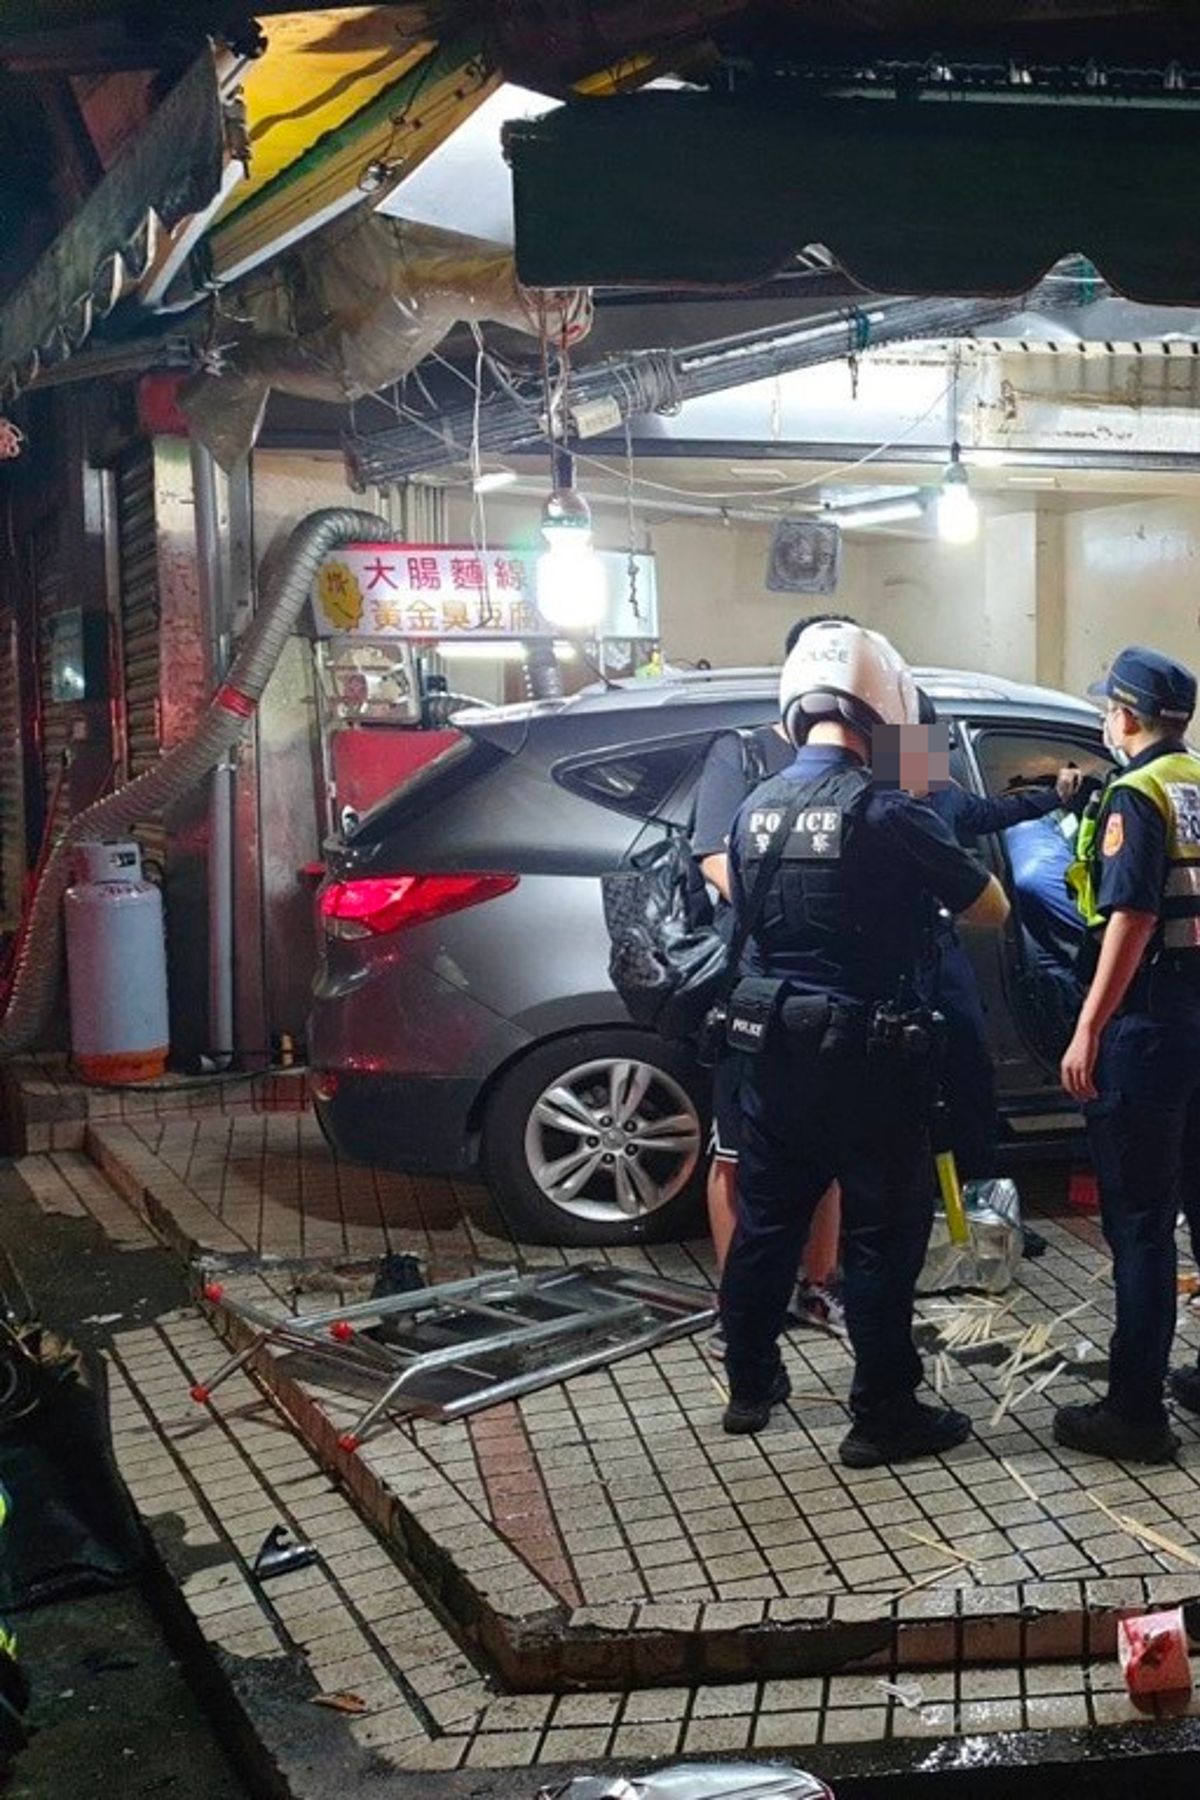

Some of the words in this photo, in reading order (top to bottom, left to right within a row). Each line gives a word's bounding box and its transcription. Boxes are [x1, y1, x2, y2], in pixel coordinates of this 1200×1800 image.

[363, 556, 526, 592] 大腸麵線
[750, 812, 839, 833] POICE
